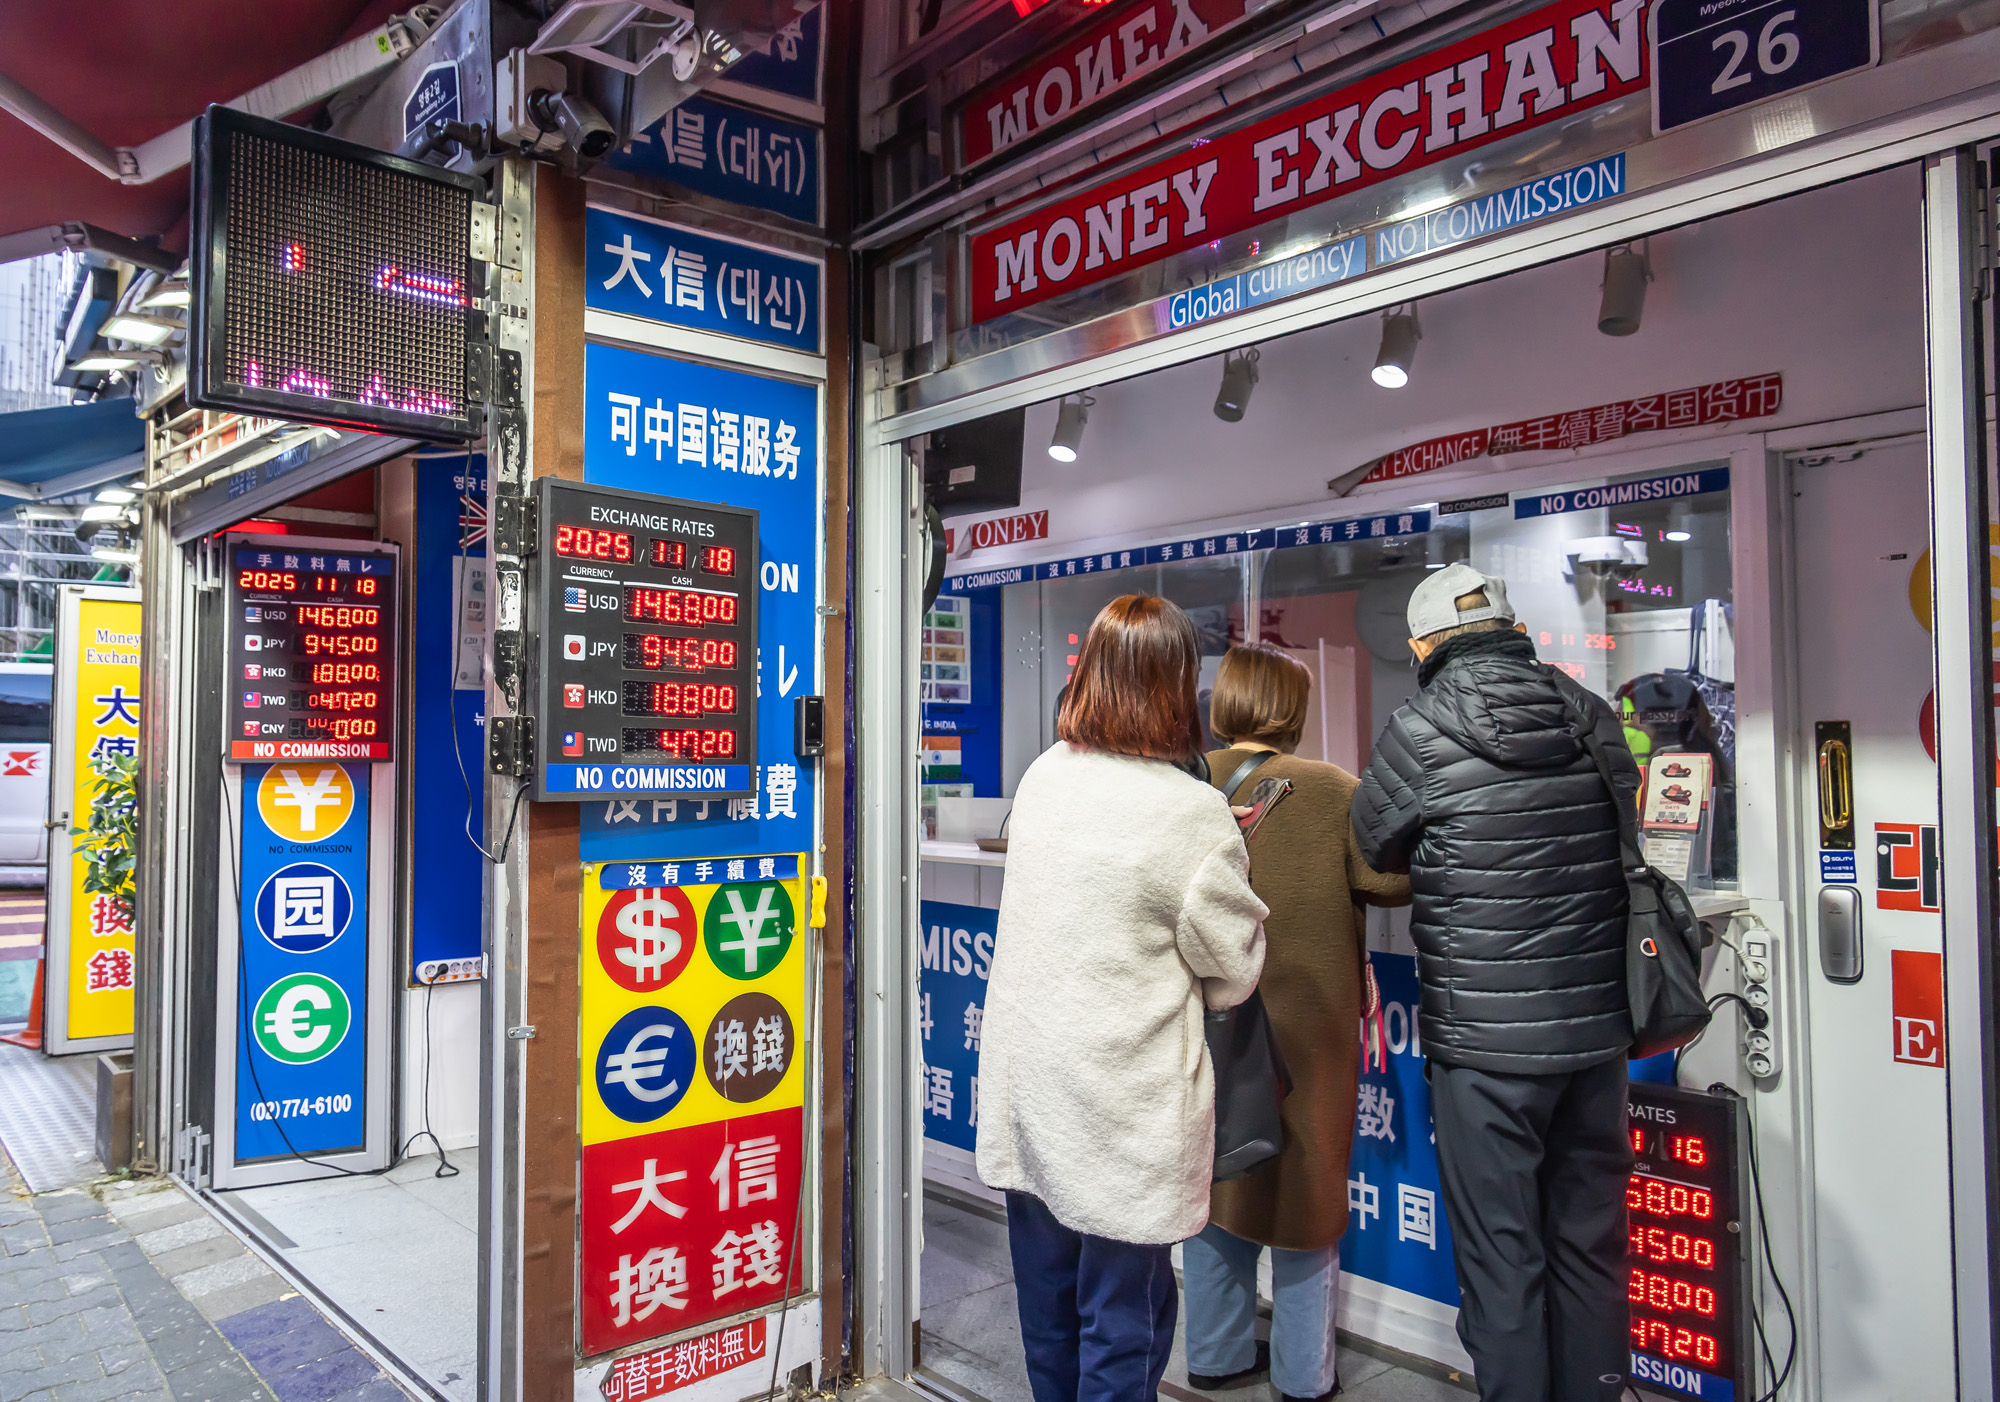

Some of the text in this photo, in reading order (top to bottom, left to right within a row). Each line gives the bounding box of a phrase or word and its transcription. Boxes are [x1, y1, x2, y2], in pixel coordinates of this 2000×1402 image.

[1700, 0, 1746, 16] Myeo
[1711, 9, 1800, 95] 26
[994, 0, 1652, 303] MONEY EXCHAN
[1170, 156, 1621, 328] Global currency NO COMMISSION
[608, 391, 801, 481] 可中国语服务
[1393, 436, 1480, 475] EXCHANGE
[453, 475, 477, 491] 영국
[1541, 474, 1700, 514] NO COMMISSION
[1455, 496, 1507, 512] COMMISSION
[590, 506, 715, 538] EXCHANGE RATES
[975, 511, 1047, 547] ONEY
[556, 526, 733, 573] 2025 11 18
[239, 571, 377, 595] 2025 11 18
[570, 565, 693, 586] CURRENCY CASH
[760, 561, 799, 593] ON
[951, 568, 1022, 591] NO COMMISSION
[589, 594, 619, 611] USD
[264, 610, 287, 621] USD
[96, 629, 141, 648] Money
[263, 638, 286, 649] JPY
[589, 641, 617, 659] JPY
[86, 649, 141, 668] Exchan
[262, 667, 287, 678] HKD
[262, 695, 286, 706] TWD
[588, 689, 618, 705] HKD
[261, 723, 285, 735] CNY
[933, 720, 957, 729] INDIA
[253, 742, 371, 758] NO COMMISSION
[587, 737, 617, 753] TWD
[575, 767, 726, 790] NO COMMISSION
[268, 844, 353, 855] NO COMMISSION
[714, 1014, 786, 1082] 換錢
[1627, 1102, 1677, 1125] RATES
[1676, 1138, 1704, 1164] 16
[609, 1134, 782, 1236] 大信
[1347, 1171, 1436, 1251] 中国
[608, 1218, 785, 1329] 換錢
